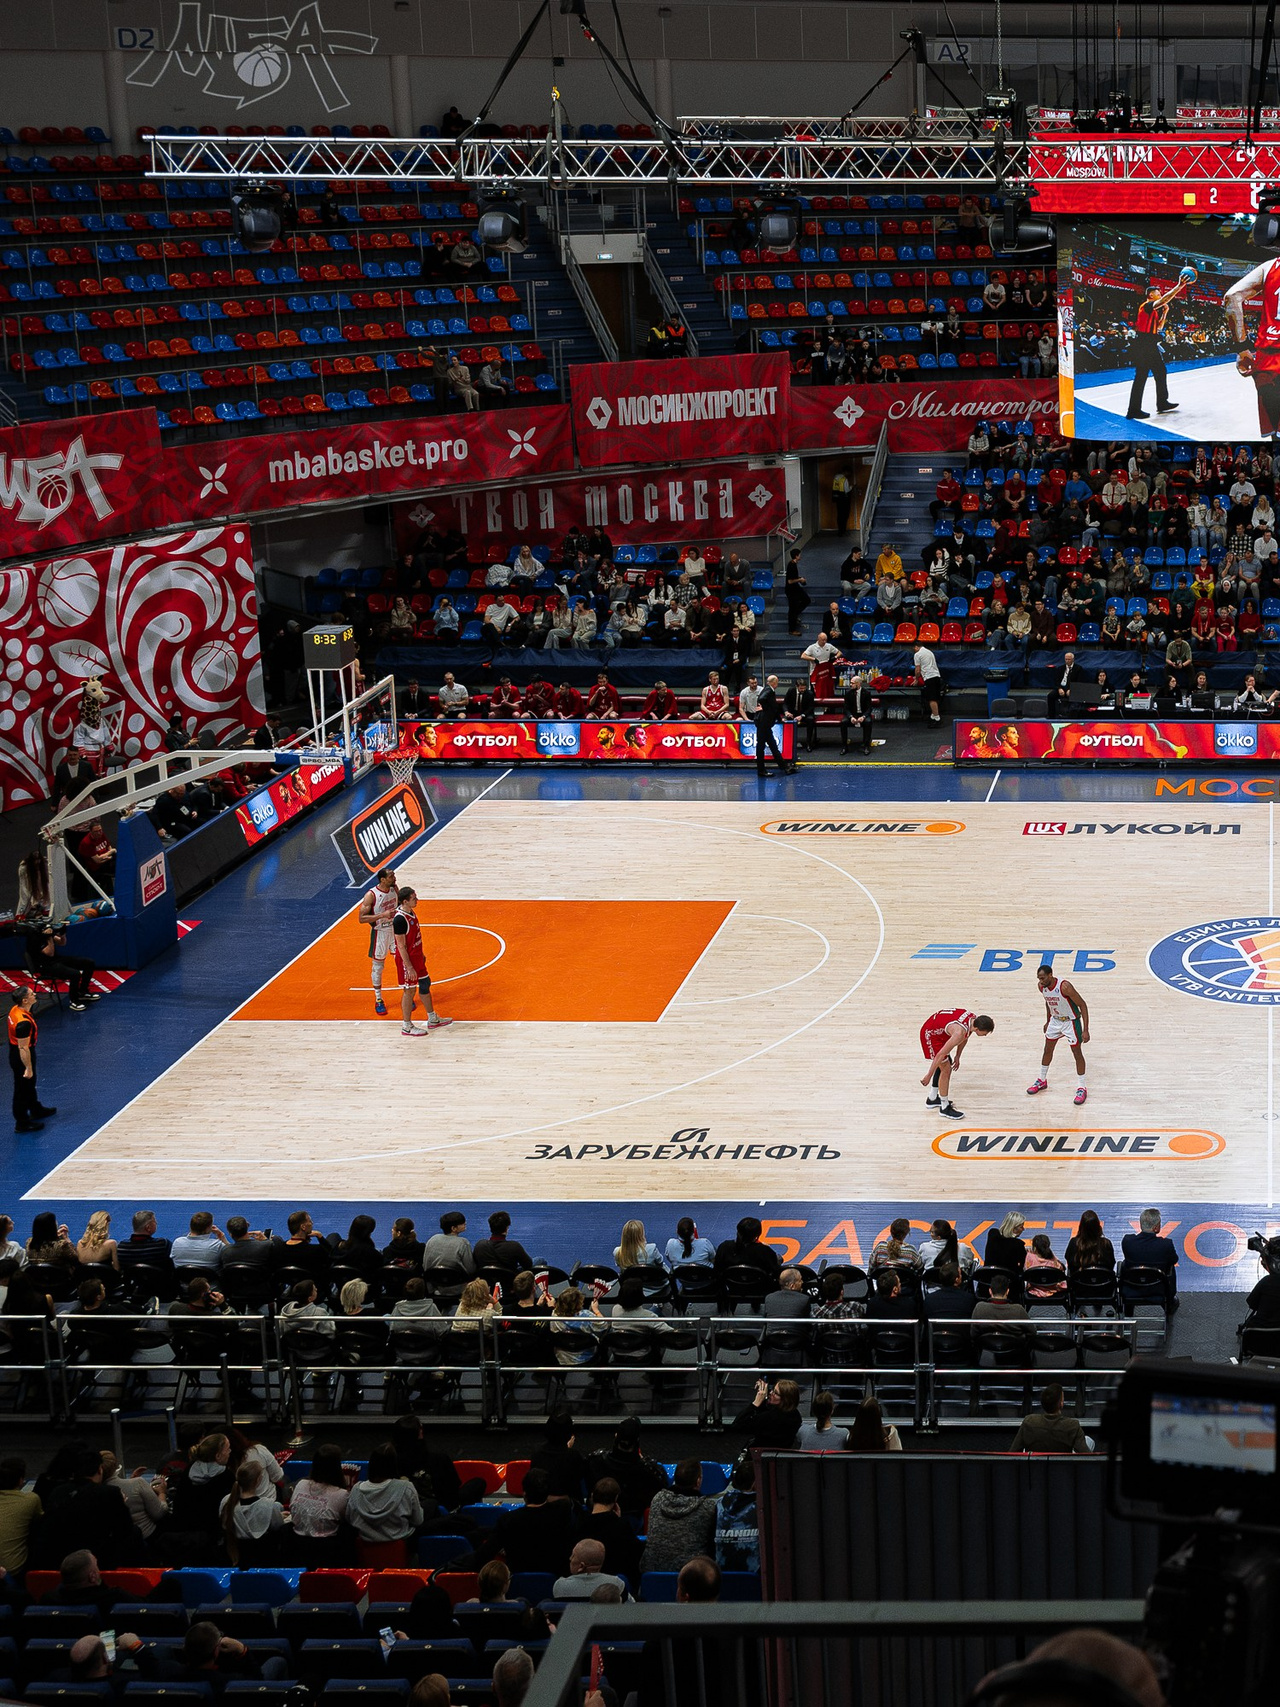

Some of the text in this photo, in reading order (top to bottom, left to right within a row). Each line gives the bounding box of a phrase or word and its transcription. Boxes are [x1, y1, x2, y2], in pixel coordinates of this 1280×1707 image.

[118, 29, 155, 49] D2
[937, 44, 969, 62] A2
[1066, 167, 1106, 178] MOSCOW
[1209, 187, 1217, 204] 2
[618, 386, 778, 426] МОСИНЖПРОЕКТ
[268, 438, 469, 482] mbabasket.pro
[452, 478, 734, 534] ТВОЯ МОСКВА
[313, 634, 337, 645] 8:32
[453, 735, 517, 747] ФУТБОЛ
[662, 735, 726, 748] ФУТБОЛ
[1079, 735, 1143, 747] ФУТБОЛ
[358, 800, 412, 862] WINLINE
[777, 821, 922, 834] WINLINE
[1067, 821, 1241, 835] ЛУКОЙЛ
[1173, 919, 1261, 944] ЕДИНАЯ
[978, 949, 1117, 973] ВТБ
[1168, 973, 1203, 992] VTB
[524, 1143, 841, 1162] ЗАРУБЕЖНЕФТЬ
[955, 1135, 1161, 1154] WINLINE
